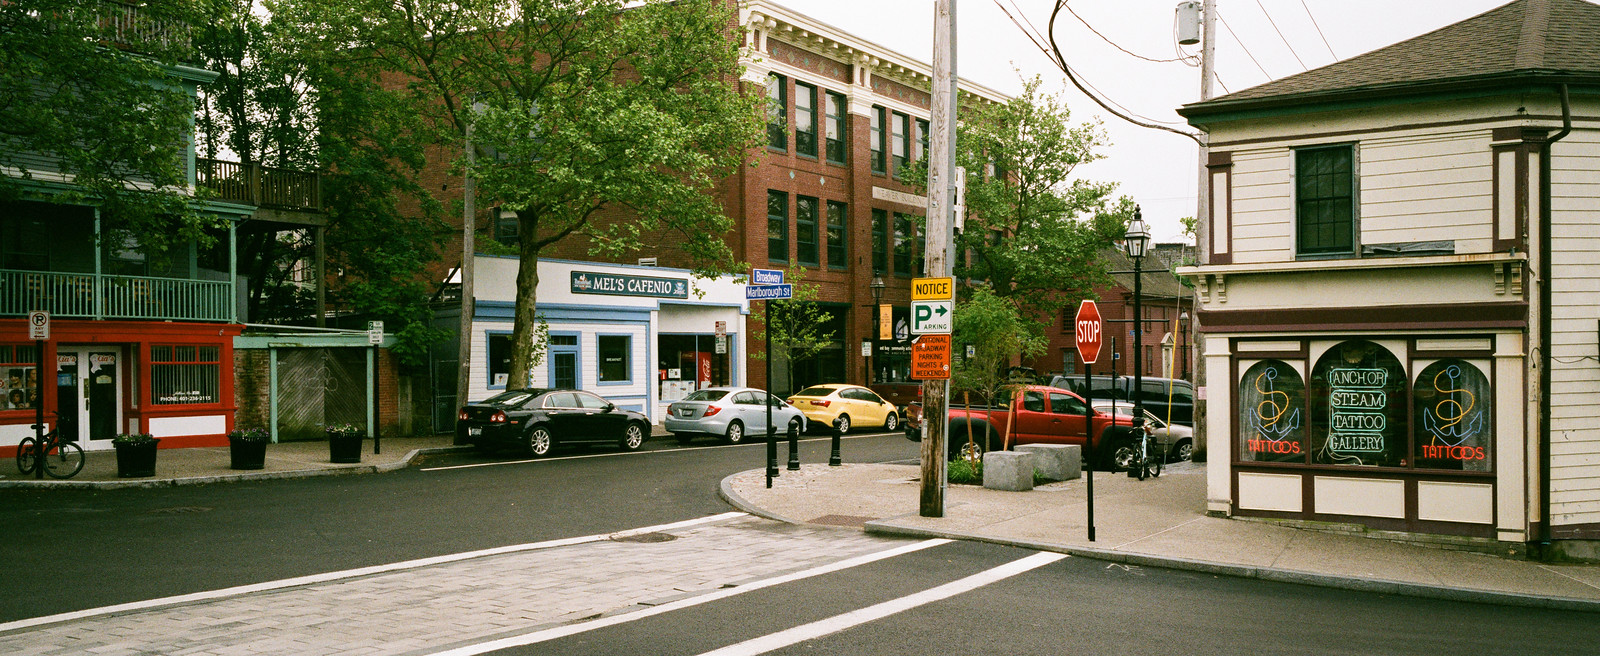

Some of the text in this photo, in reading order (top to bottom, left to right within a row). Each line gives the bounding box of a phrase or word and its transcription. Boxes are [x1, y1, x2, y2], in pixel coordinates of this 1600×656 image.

[756, 271, 780, 283] Broadway
[593, 276, 672, 294] MEL'S CAFENIO
[747, 286, 790, 298] Marlborough St
[915, 283, 948, 295] NOTICE
[1078, 320, 1100, 343] STOP
[916, 361, 938, 369] NIGHTS
[1333, 371, 1385, 385] ANCHOR
[1332, 392, 1384, 407] STEAM
[1333, 415, 1383, 429] TATTOO
[1248, 439, 1300, 454] TATTOOS
[1331, 436, 1381, 450] GALLERY
[1422, 445, 1485, 460] TATTOOS
